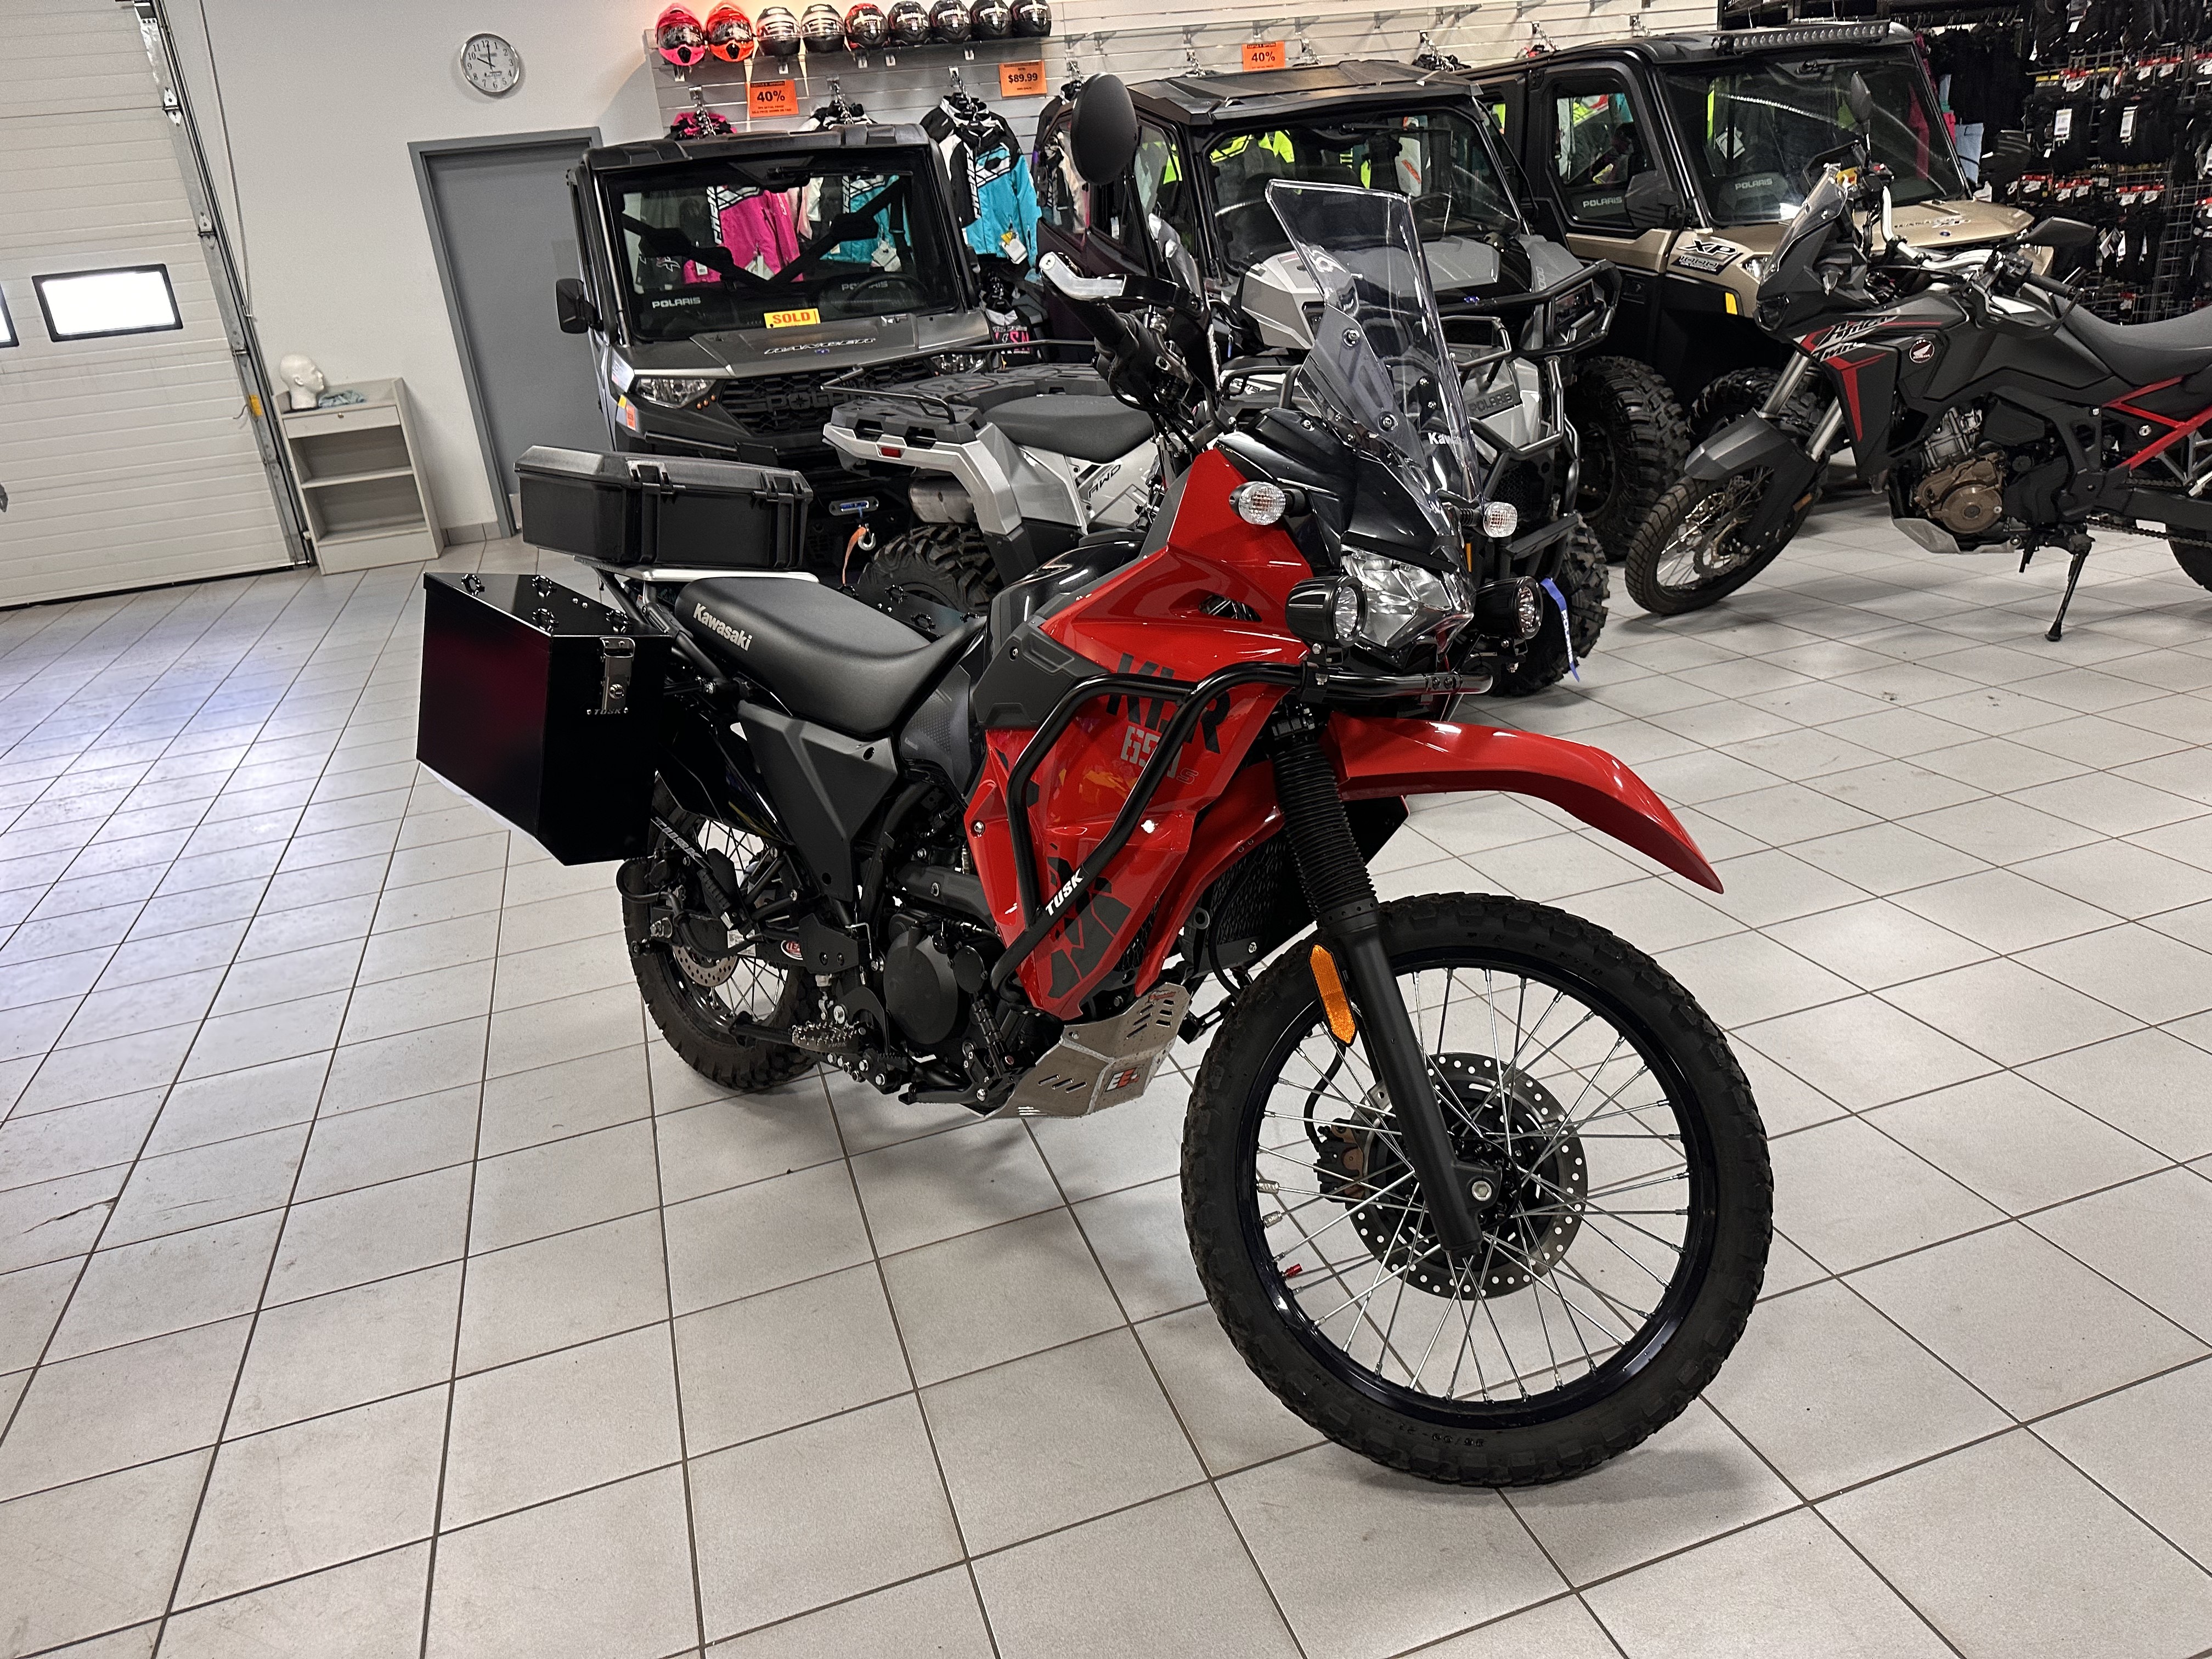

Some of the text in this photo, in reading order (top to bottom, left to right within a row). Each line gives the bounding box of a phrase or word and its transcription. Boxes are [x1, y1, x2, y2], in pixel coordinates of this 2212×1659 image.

[473, 44, 480, 52] 11
[503, 48, 508, 57] 2
[468, 52, 476, 60] 10
[1251, 51, 1276, 62] 40%
[473, 72, 478, 81] 8
[1008, 72, 1038, 84] $89.99
[482, 79, 486, 87] 7
[757, 90, 786, 102] 40%
[1735, 178, 1773, 190] POLARIS
[1582, 196, 1622, 208] POLARIS
[1681, 239, 1737, 255] XP
[652, 297, 701, 308] POLARIS
[772, 312, 811, 324] SOLD
[1468, 392, 1513, 415] POLARIS
[693, 602, 753, 651] Kawasaki
[1045, 867, 1084, 917] TUSK
